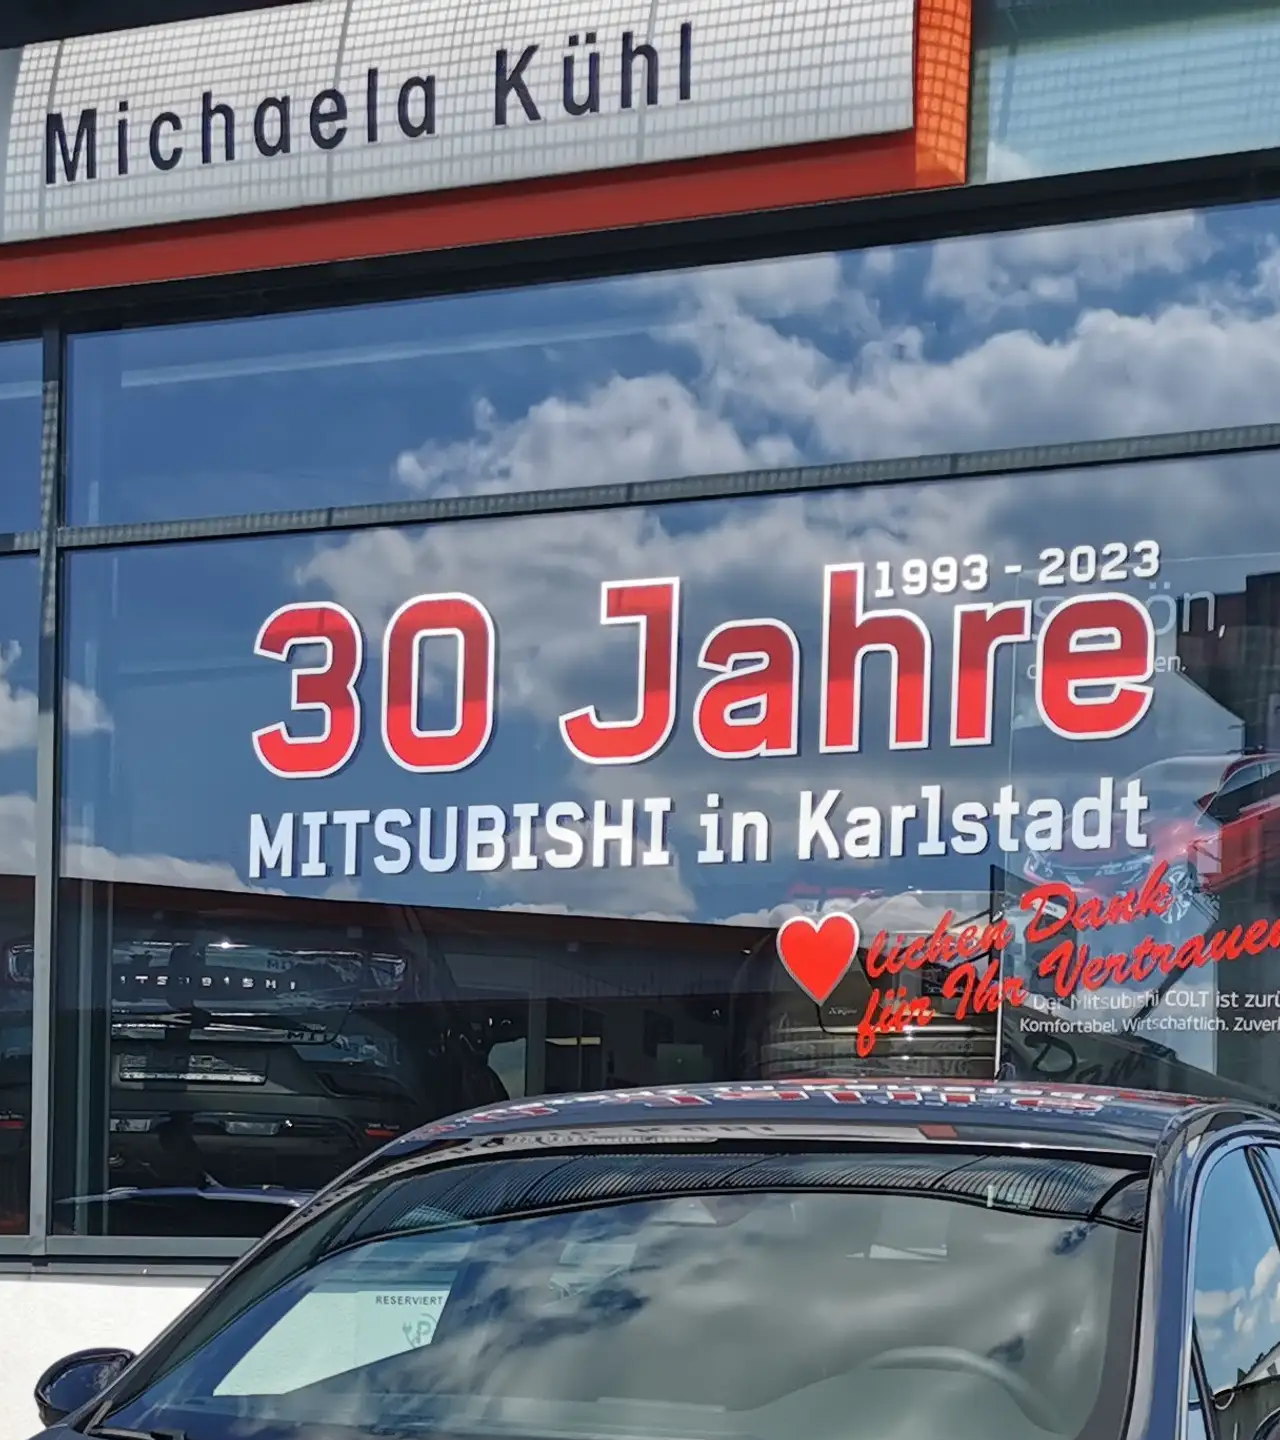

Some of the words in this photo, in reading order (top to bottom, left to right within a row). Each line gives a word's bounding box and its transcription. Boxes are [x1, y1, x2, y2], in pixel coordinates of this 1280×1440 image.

[45, 68, 437, 185] Michaela
[494, 22, 692, 126] Kühl
[875, 554, 990, 598] 1993
[1038, 540, 1161, 586] 2023
[252, 592, 495, 778] 30
[559, 562, 1155, 764] Jahre
[249, 797, 672, 878] MITSUBISHI
[697, 793, 770, 863] in
[797, 777, 1150, 862] Karlstadt
[865, 910, 1013, 979] lichen
[1020, 860, 1174, 943] Dank
[855, 986, 935, 1058] für
[942, 959, 1028, 1021] Ihr
[1122, 1016, 1229, 1033] Wirtschaftlich.
[1165, 990, 1209, 1008] COLT
[1216, 990, 1238, 1008] ist
[375, 1295, 444, 1306] RESERVIERT
